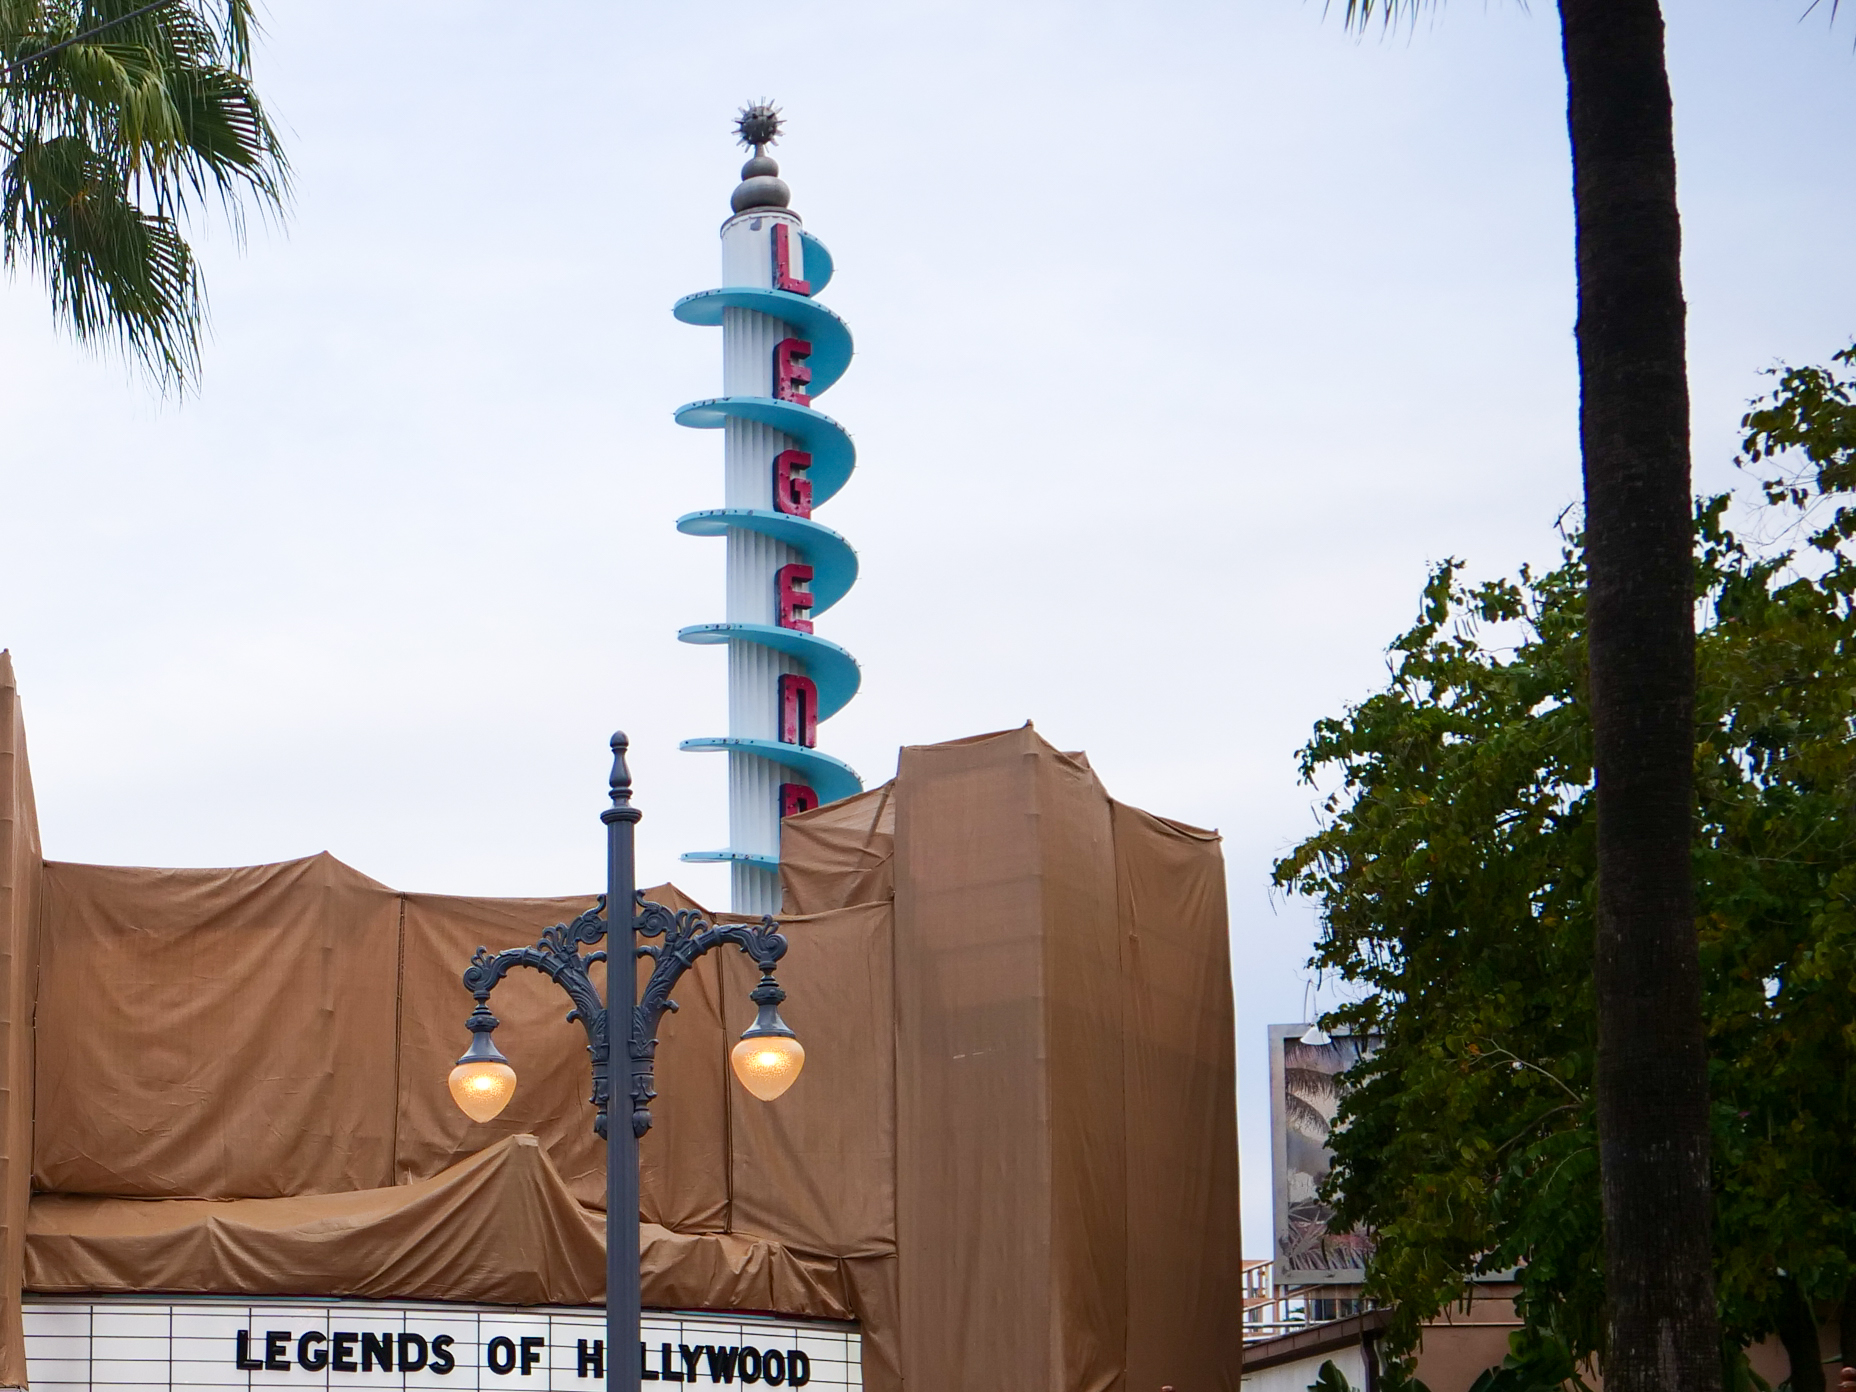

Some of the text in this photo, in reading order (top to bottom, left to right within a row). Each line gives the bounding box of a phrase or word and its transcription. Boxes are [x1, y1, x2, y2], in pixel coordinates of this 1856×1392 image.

[236, 1329, 811, 1388] LEGENDS OF HLLYWOOD
